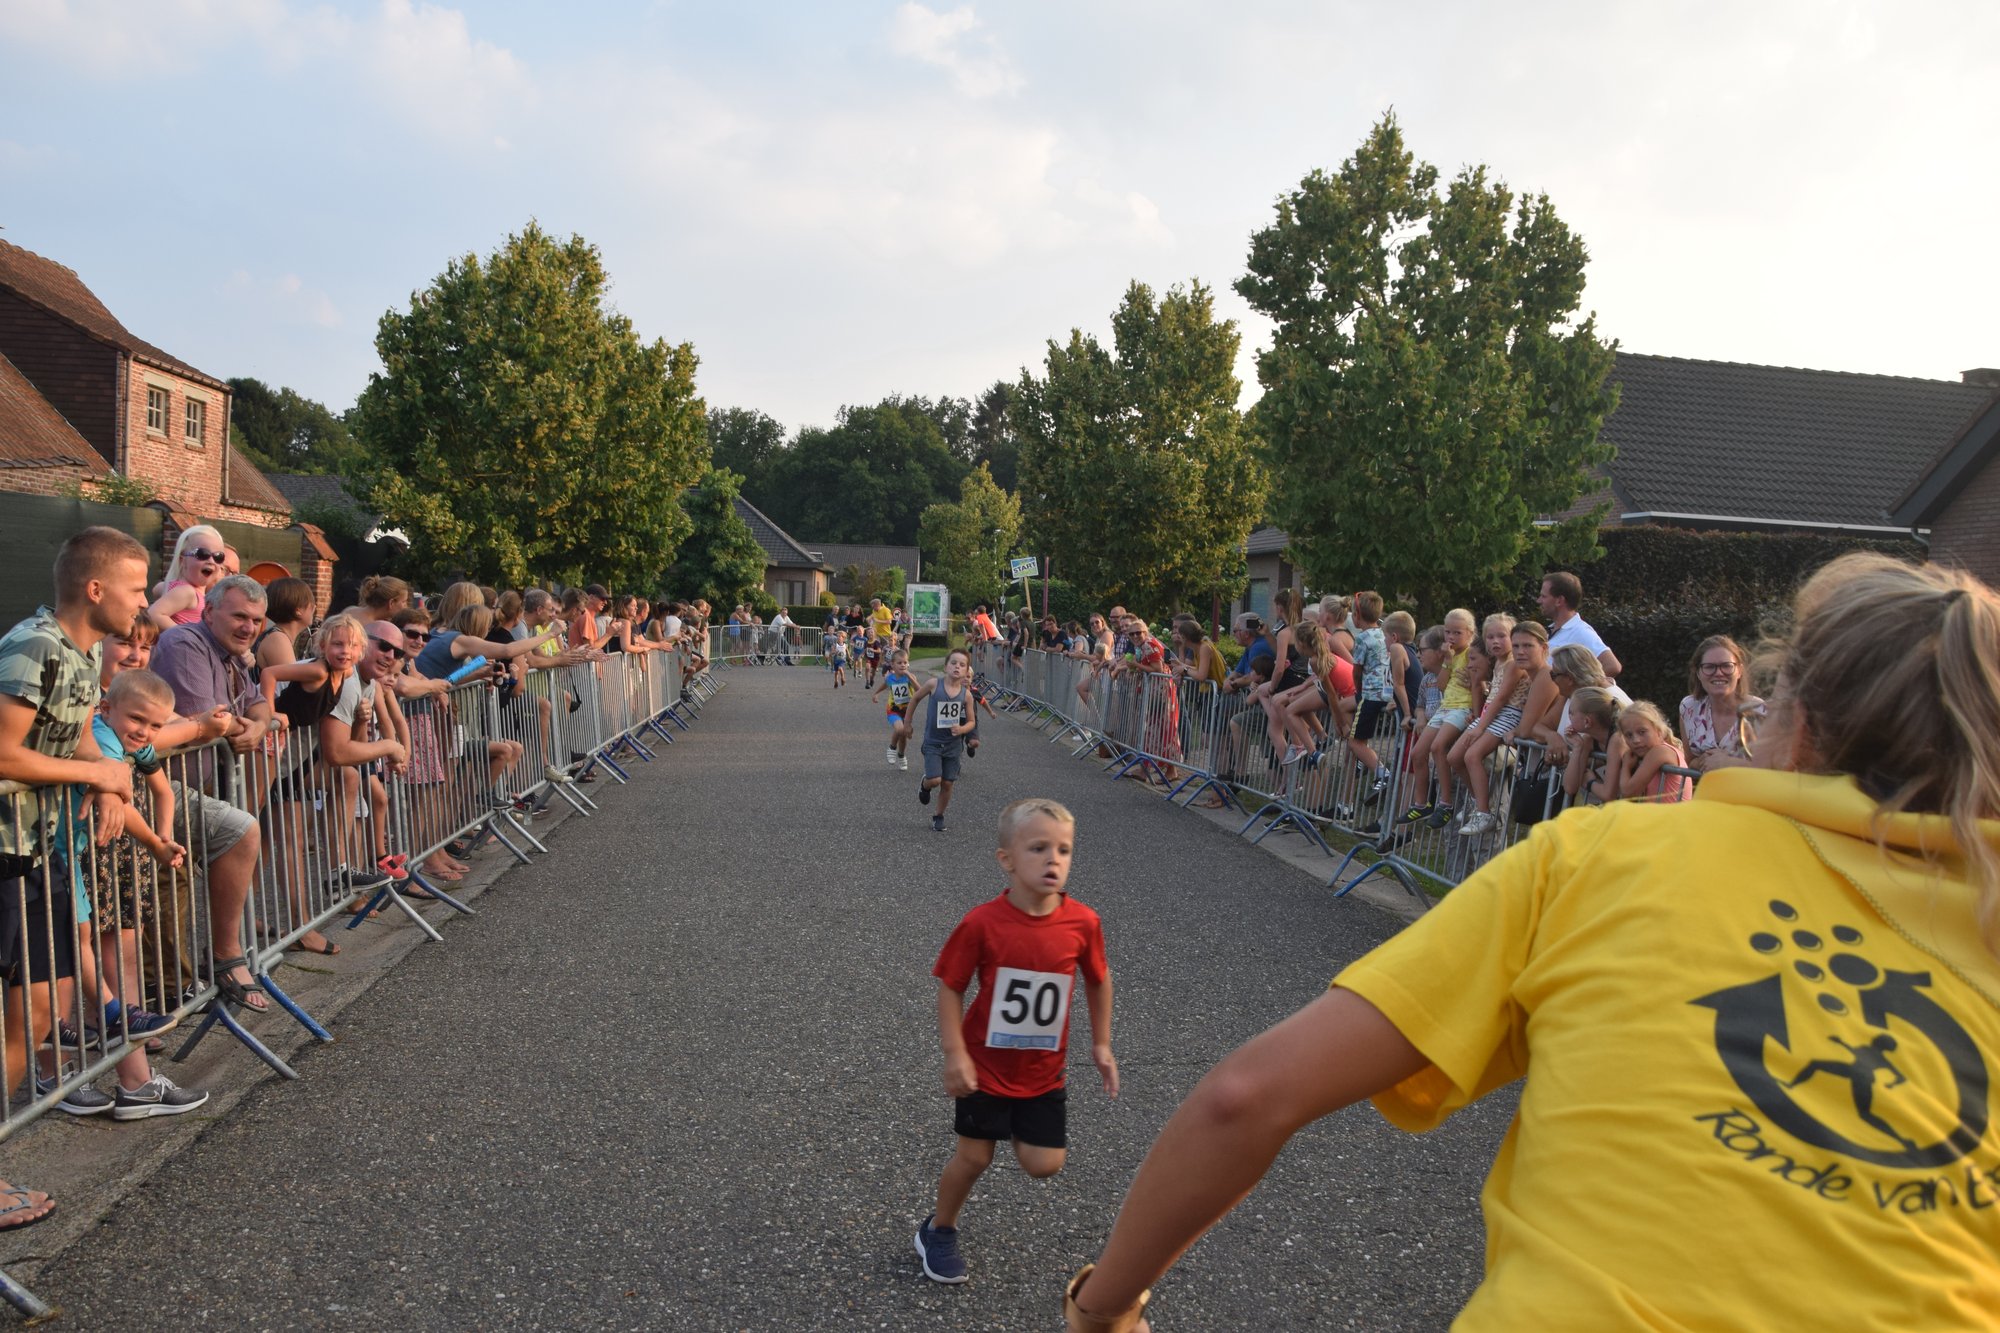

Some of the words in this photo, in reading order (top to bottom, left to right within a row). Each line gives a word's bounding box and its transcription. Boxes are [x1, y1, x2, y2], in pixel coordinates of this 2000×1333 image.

[1013, 561, 1036, 574] START
[894, 686, 908, 698] 42
[940, 703, 959, 718] 48
[1001, 978, 1060, 1027] 50
[1693, 1106, 1852, 1201] Ronde
[1873, 1177, 1958, 1214] van
